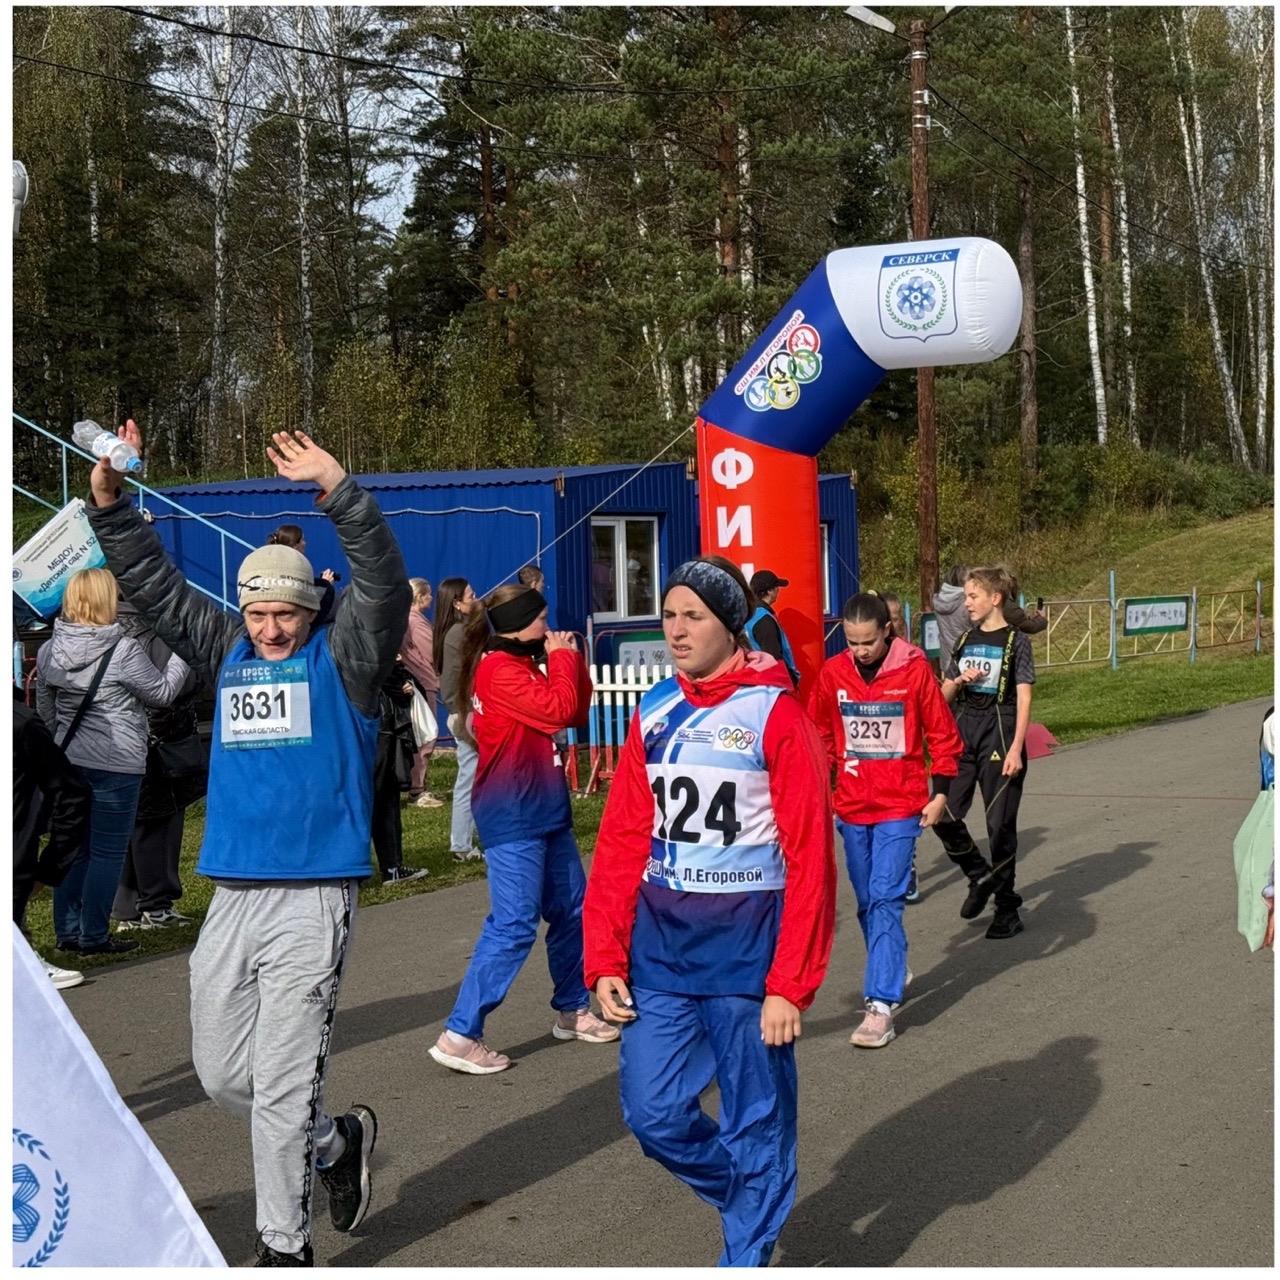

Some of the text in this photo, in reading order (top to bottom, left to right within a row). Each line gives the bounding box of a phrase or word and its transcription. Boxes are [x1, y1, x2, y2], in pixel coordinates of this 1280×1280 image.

[889, 250, 953, 266] СЕВЕРСК
[736, 379, 749, 393] СШ
[47, 543, 75, 572] МБДОУ
[68, 552, 83, 566] сад
[86, 536, 98, 548] 52
[242, 666, 271, 677] КРОСС
[230, 689, 287, 721] 3631
[257, 726, 290, 735] ОБЛАСТЬ
[849, 720, 893, 740] 3237
[651, 775, 742, 847] 124
[683, 866, 763, 886] Л.Егоровой
